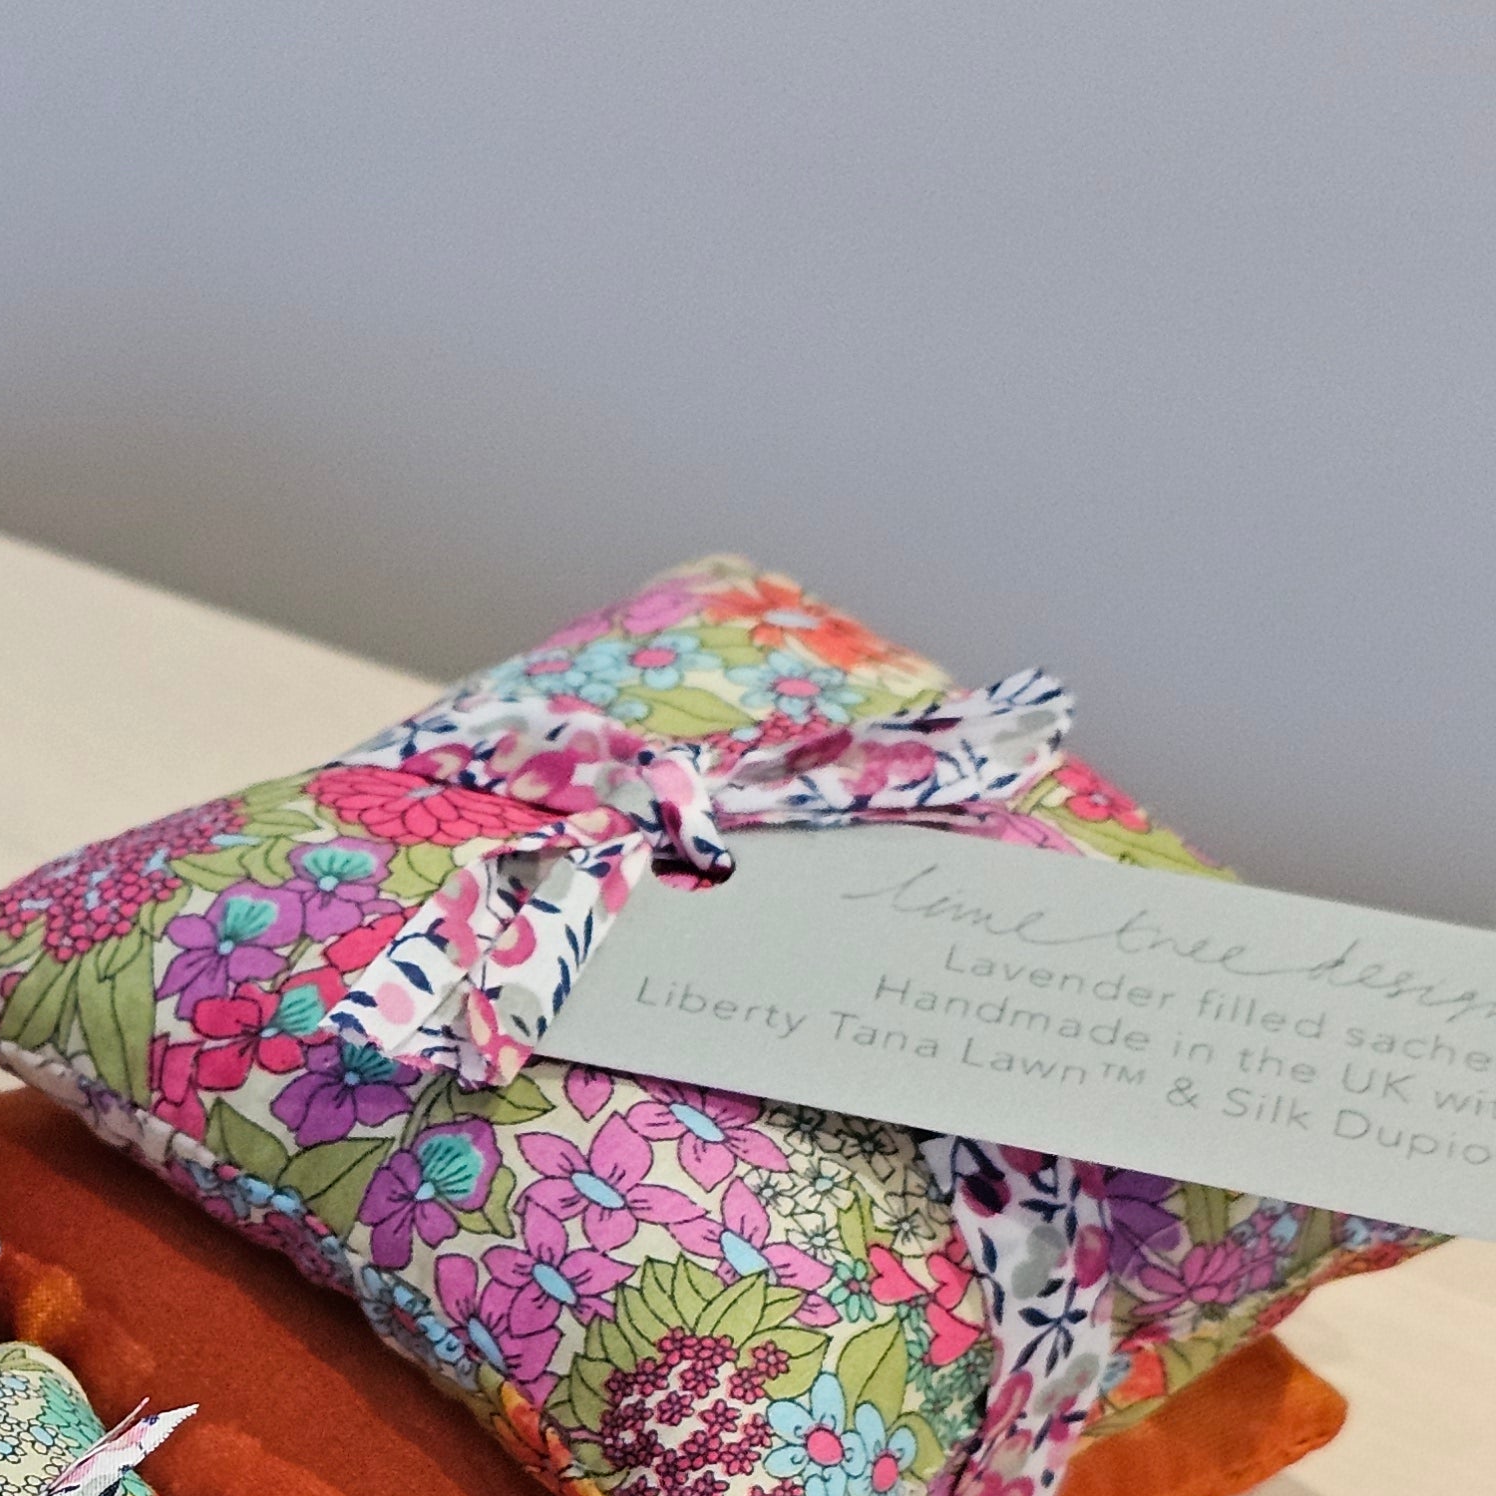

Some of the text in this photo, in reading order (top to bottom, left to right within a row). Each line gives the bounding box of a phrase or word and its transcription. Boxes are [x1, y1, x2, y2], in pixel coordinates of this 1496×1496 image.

[841, 864, 1094, 945] lime
[1114, 909, 1279, 976] tree
[636, 977, 806, 1038] Liberty
[830, 1011, 939, 1057] Tana
[1166, 1076, 1200, 1110] &
[1221, 1090, 1312, 1131] Silk
[1333, 1108, 1496, 1165] Dupio
[875, 975, 1149, 1053] Handmade
[1173, 1034, 1215, 1063] in
[1238, 1045, 1318, 1084] the
[1341, 1063, 1415, 1103] UK
[945, 944, 1496, 1072] Lavender filled sache
